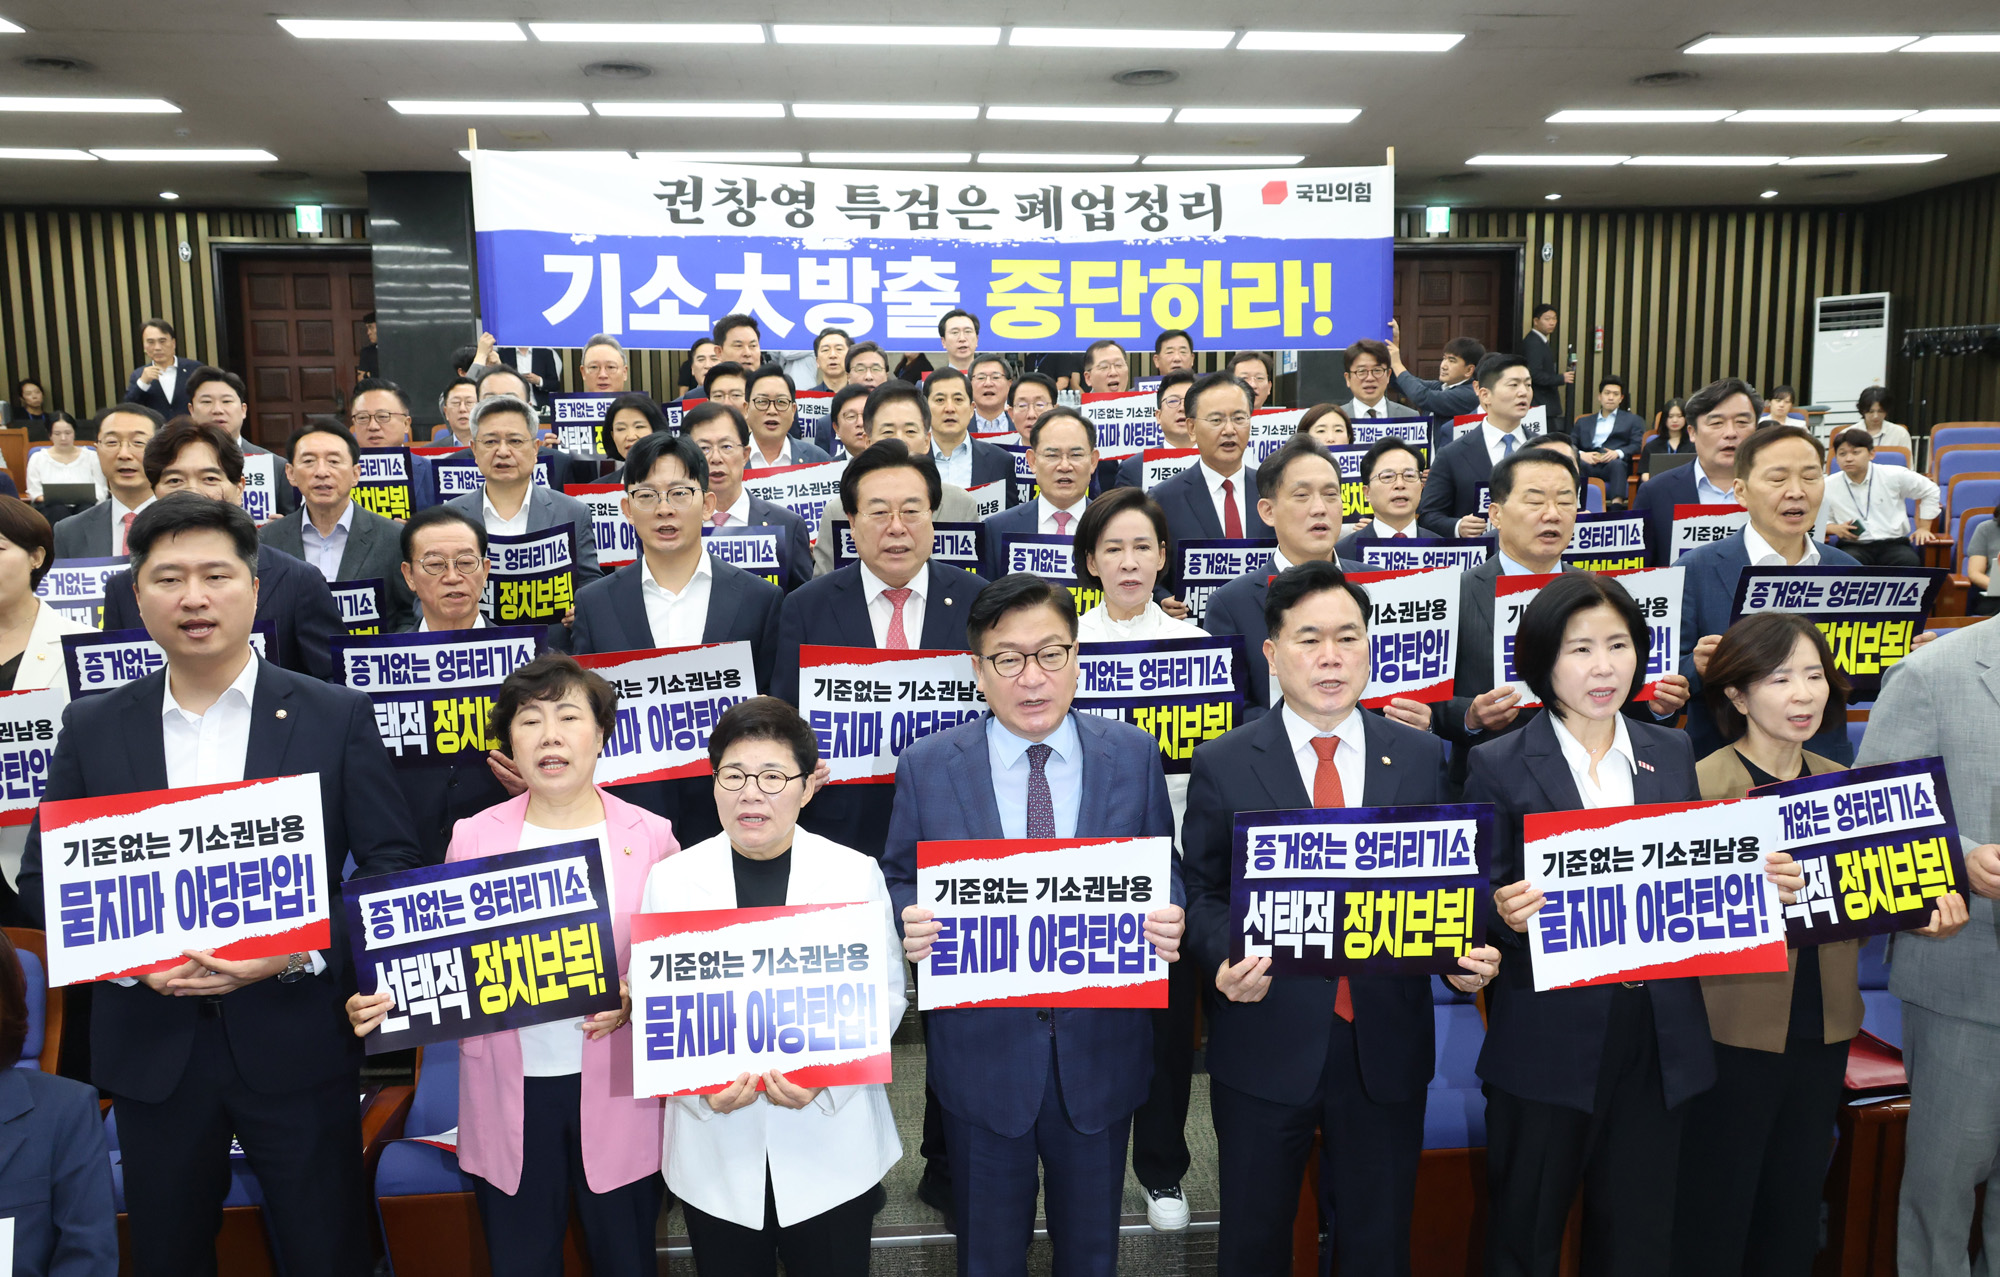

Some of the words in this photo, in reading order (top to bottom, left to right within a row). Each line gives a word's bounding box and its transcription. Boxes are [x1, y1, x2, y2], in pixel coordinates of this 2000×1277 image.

[653, 174, 815, 229] 권창영
[836, 183, 1000, 231] 특검은
[1014, 183, 1223, 233] 폐업정리
[1296, 181, 1372, 203] 국민의힘
[986, 258, 1333, 340] 중단하라!
[558, 401, 594, 418] 증거없는
[798, 404, 829, 415] 기준없는
[1088, 408, 1124, 419] 기준없는
[1126, 407, 1157, 418] 기소권
[558, 426, 594, 454] 선택적
[1094, 423, 1120, 448] 지마
[1263, 425, 1298, 436] 기소권남
[359, 458, 403, 477] 터리기소
[443, 470, 485, 489] 증거없는
[751, 486, 784, 500] 준없는
[787, 481, 841, 498] 기소권남용
[588, 502, 618, 516] 준없는
[933, 534, 973, 555] 리기소
[1579, 523, 1641, 549] 엉터리기소
[504, 539, 568, 570] 엉터리기소
[1013, 548, 1067, 573] 증거없는
[1189, 552, 1241, 575] 증거없는
[500, 571, 575, 620] 정치보복!
[1750, 581, 1824, 608] 증거없는
[1826, 581, 1919, 607] 엉터리기소
[84, 648, 163, 683] 증거없는
[351, 652, 430, 686] 증거없는
[1079, 660, 1133, 691] 거없는
[1139, 655, 1228, 691] 엉터리기소
[647, 669, 741, 695] 기소권남용
[814, 678, 892, 702] 기준없는
[0, 719, 53, 743] 권남용
[374, 700, 428, 756] 택적
[810, 710, 883, 759] 묻지마
[1779, 800, 1831, 841] 거없는
[1834, 782, 1935, 832] 엉터리기소
[63, 832, 171, 868] 기준없는
[179, 815, 305, 854] 기소권남용
[1254, 831, 1347, 871] 증거없는
[1355, 828, 1470, 870] 엉터리기소
[1542, 846, 1634, 878] 기준없는
[1641, 836, 1760, 869] 기소권남용
[934, 878, 1028, 905] 기준없는
[1036, 875, 1153, 903] 기소권남용
[1835, 837, 1956, 921] 정치보복!
[60, 871, 165, 948] 묻지마
[175, 853, 316, 931] 야당탄압!
[369, 889, 466, 940] 증거없는
[469, 865, 587, 921] 엉터리기소
[1538, 883, 1627, 954] 묻지마
[1636, 873, 1769, 943] 야당탄압!
[1243, 890, 1335, 959] 선택적
[1343, 887, 1475, 959] 정치보복!
[930, 914, 1019, 976] 묻지마
[375, 947, 471, 1034] 선택적
[471, 922, 606, 1015] 정치보복!
[650, 950, 745, 982] 기준없는
[752, 943, 869, 976] 기소권남용
[645, 990, 737, 1061] 묻지마
[746, 982, 878, 1054] 야당탄압!
